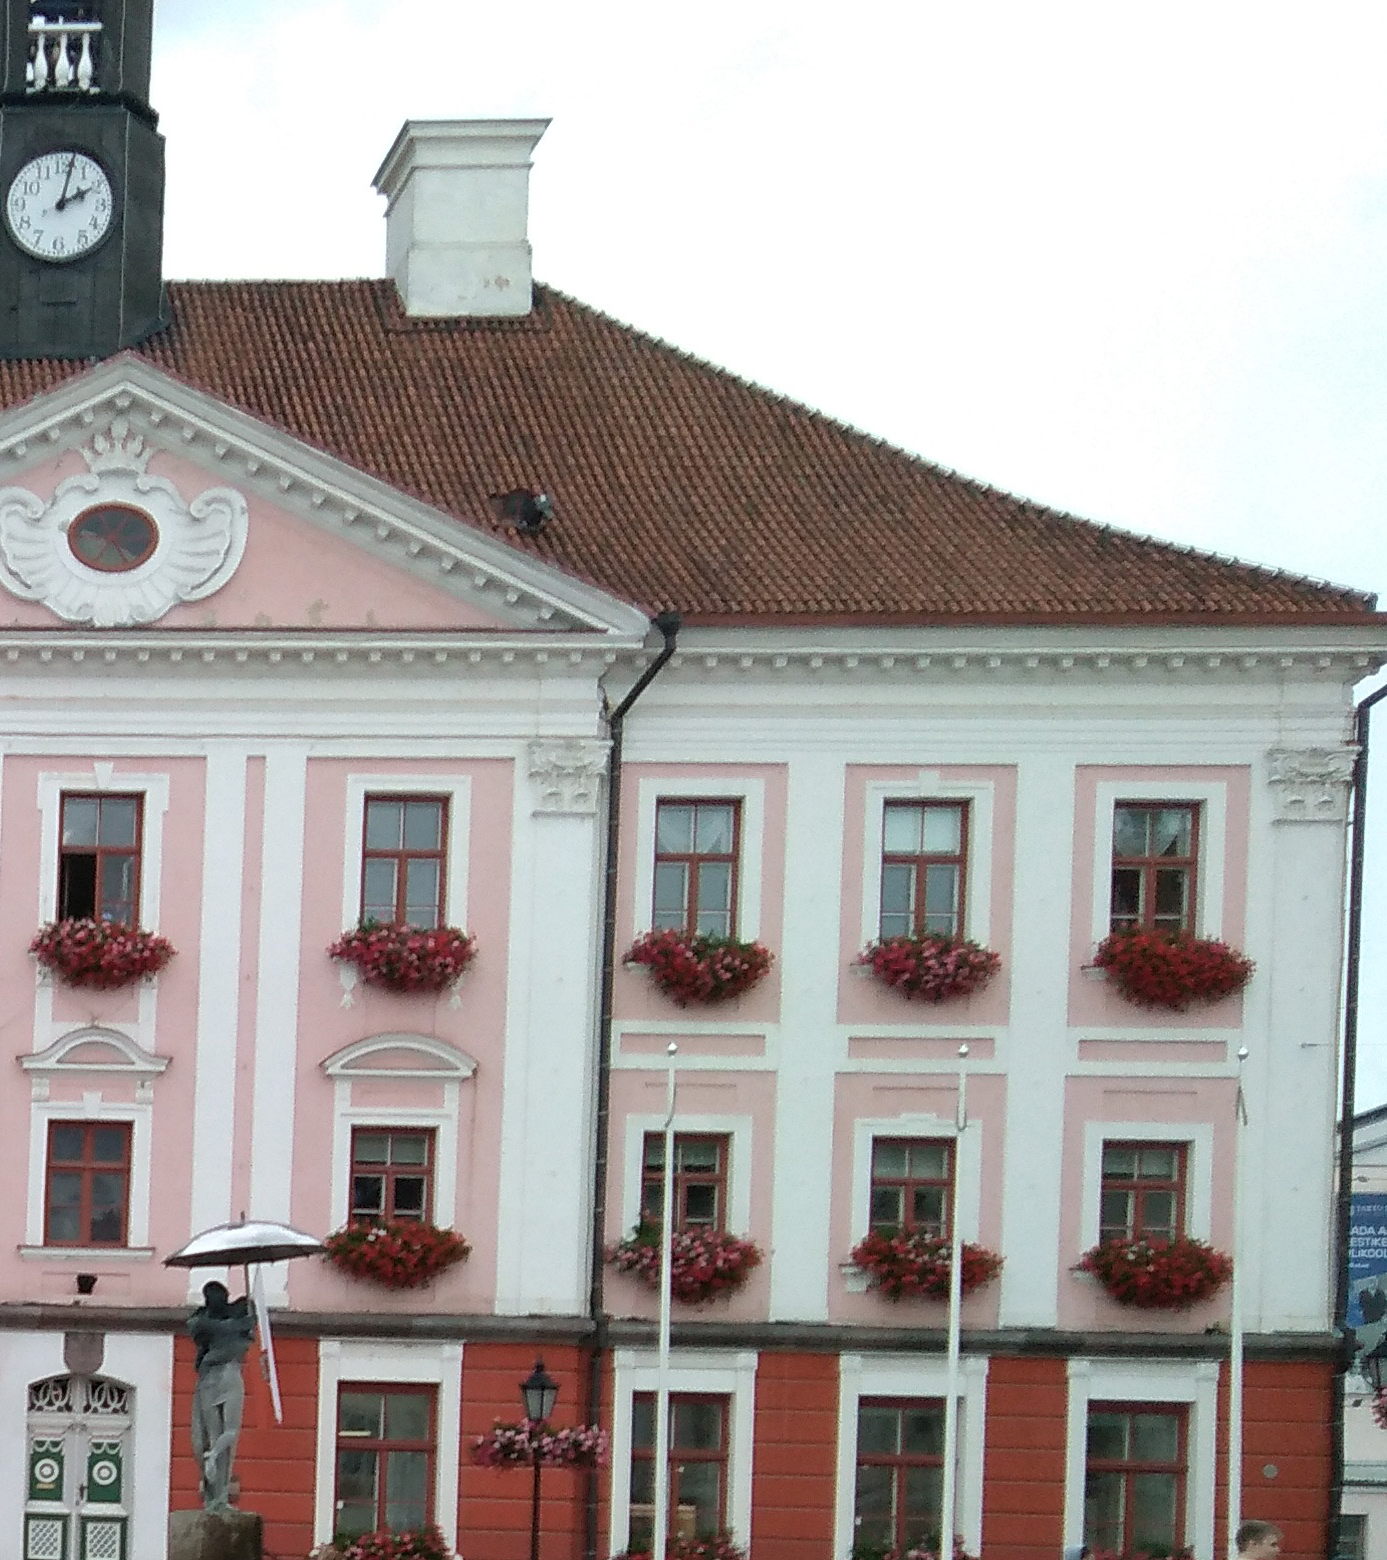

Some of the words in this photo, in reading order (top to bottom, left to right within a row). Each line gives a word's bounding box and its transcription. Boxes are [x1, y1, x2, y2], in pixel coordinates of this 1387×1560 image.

[36, 161, 51, 180] 11
[23, 181, 41, 196] 10
[95, 198, 107, 212] 3
[19, 215, 31, 230] 8
[88, 214, 99, 230] 4
[33, 229, 45, 249] 7
[52, 235, 65, 250] 6
